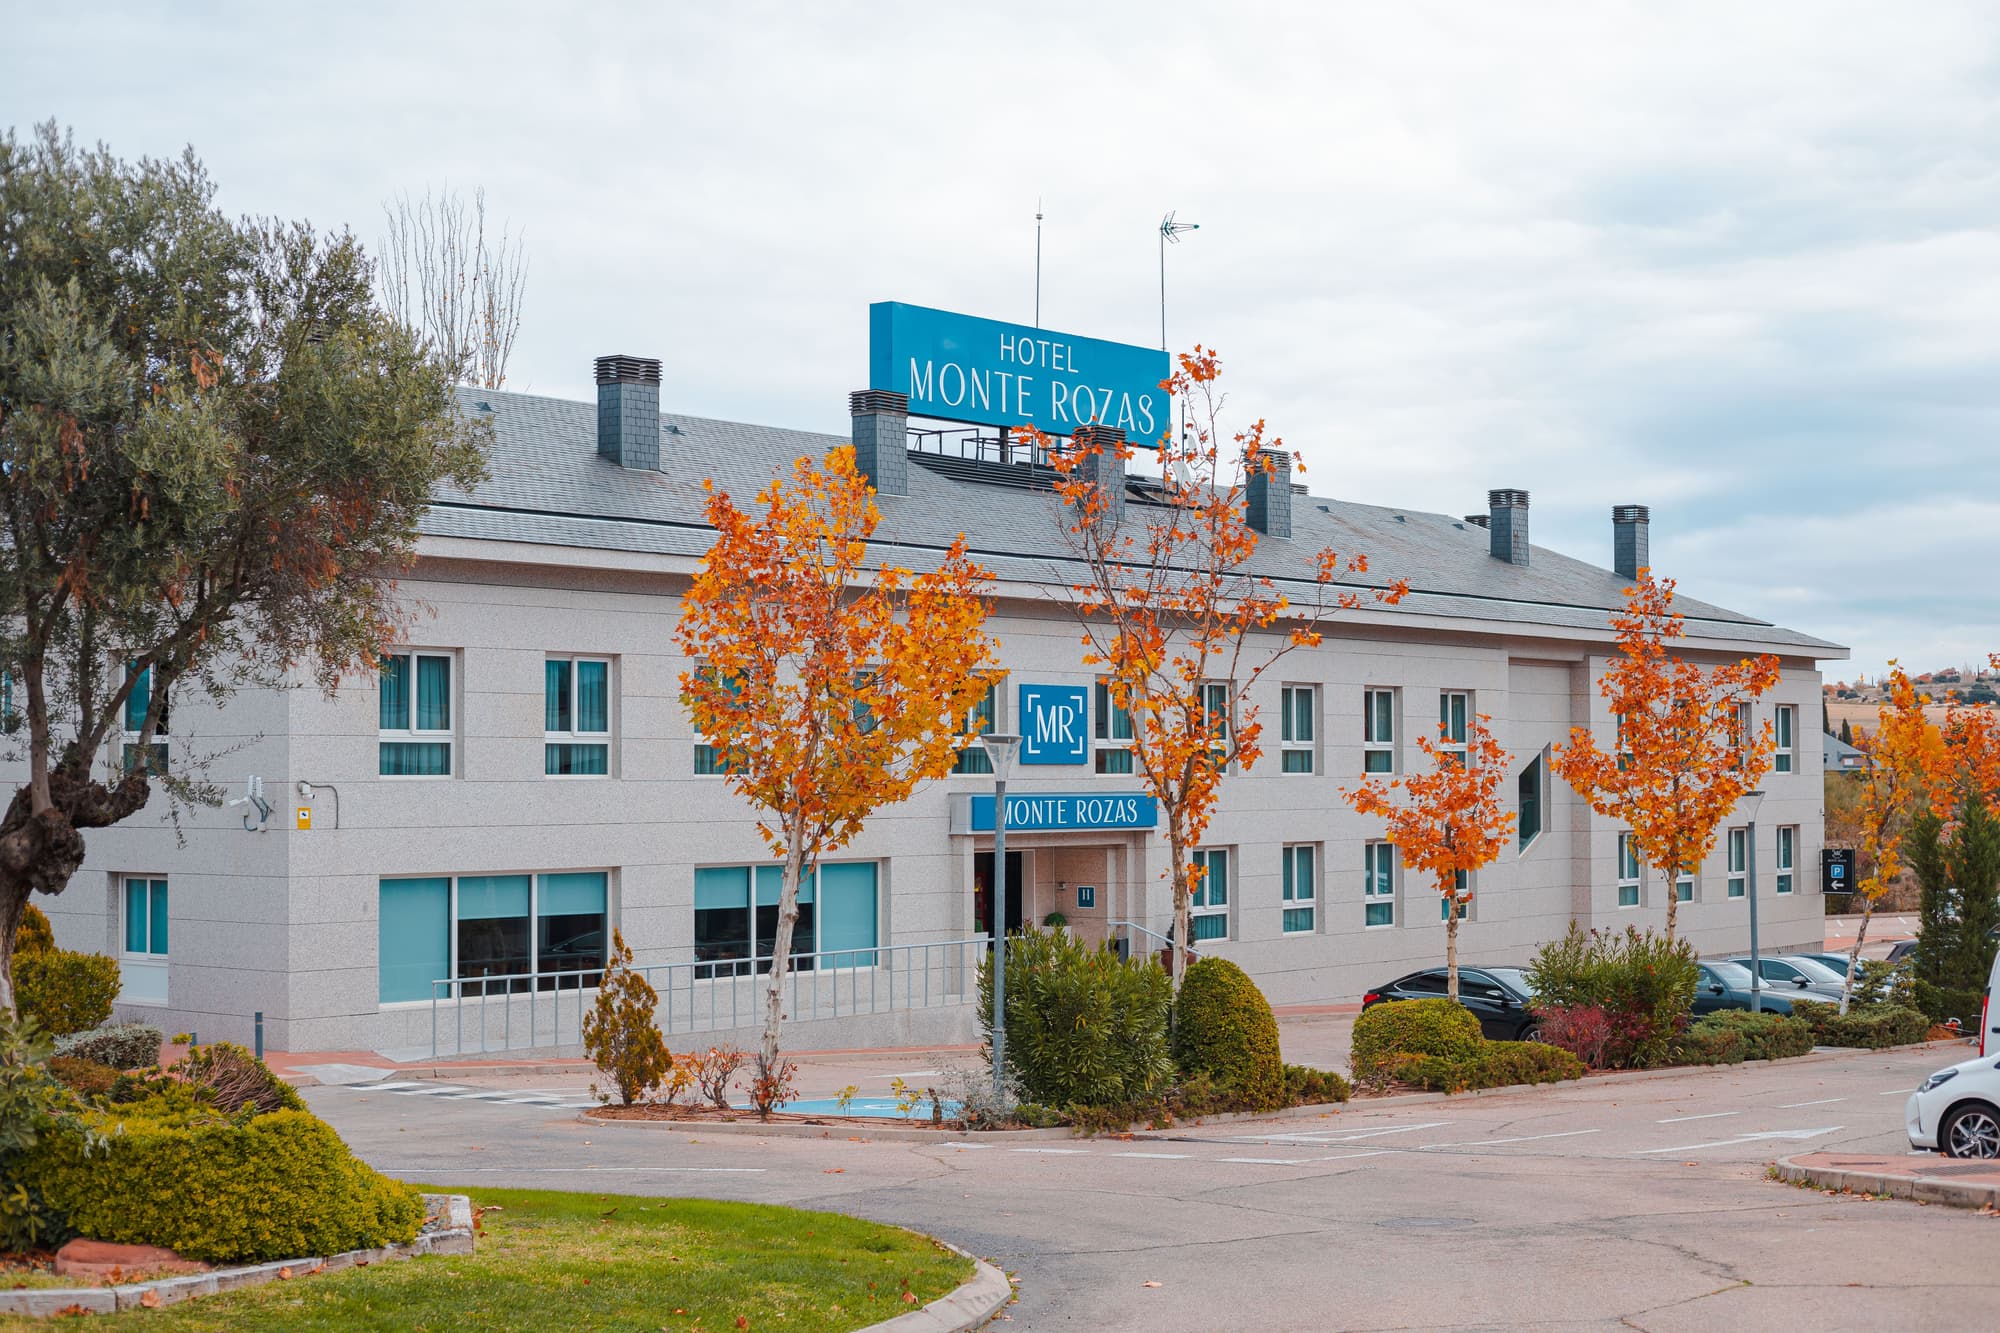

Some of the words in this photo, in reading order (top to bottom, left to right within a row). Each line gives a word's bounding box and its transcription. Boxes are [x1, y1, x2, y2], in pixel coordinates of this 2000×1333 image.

[1000, 333, 1079, 374] HOTEL
[910, 357, 1033, 417] MONTE
[1052, 380, 1155, 435] ROZAS
[1036, 705, 1075, 743] MR
[1076, 799, 1137, 824] ROZAS
[1834, 867, 1841, 876] P
